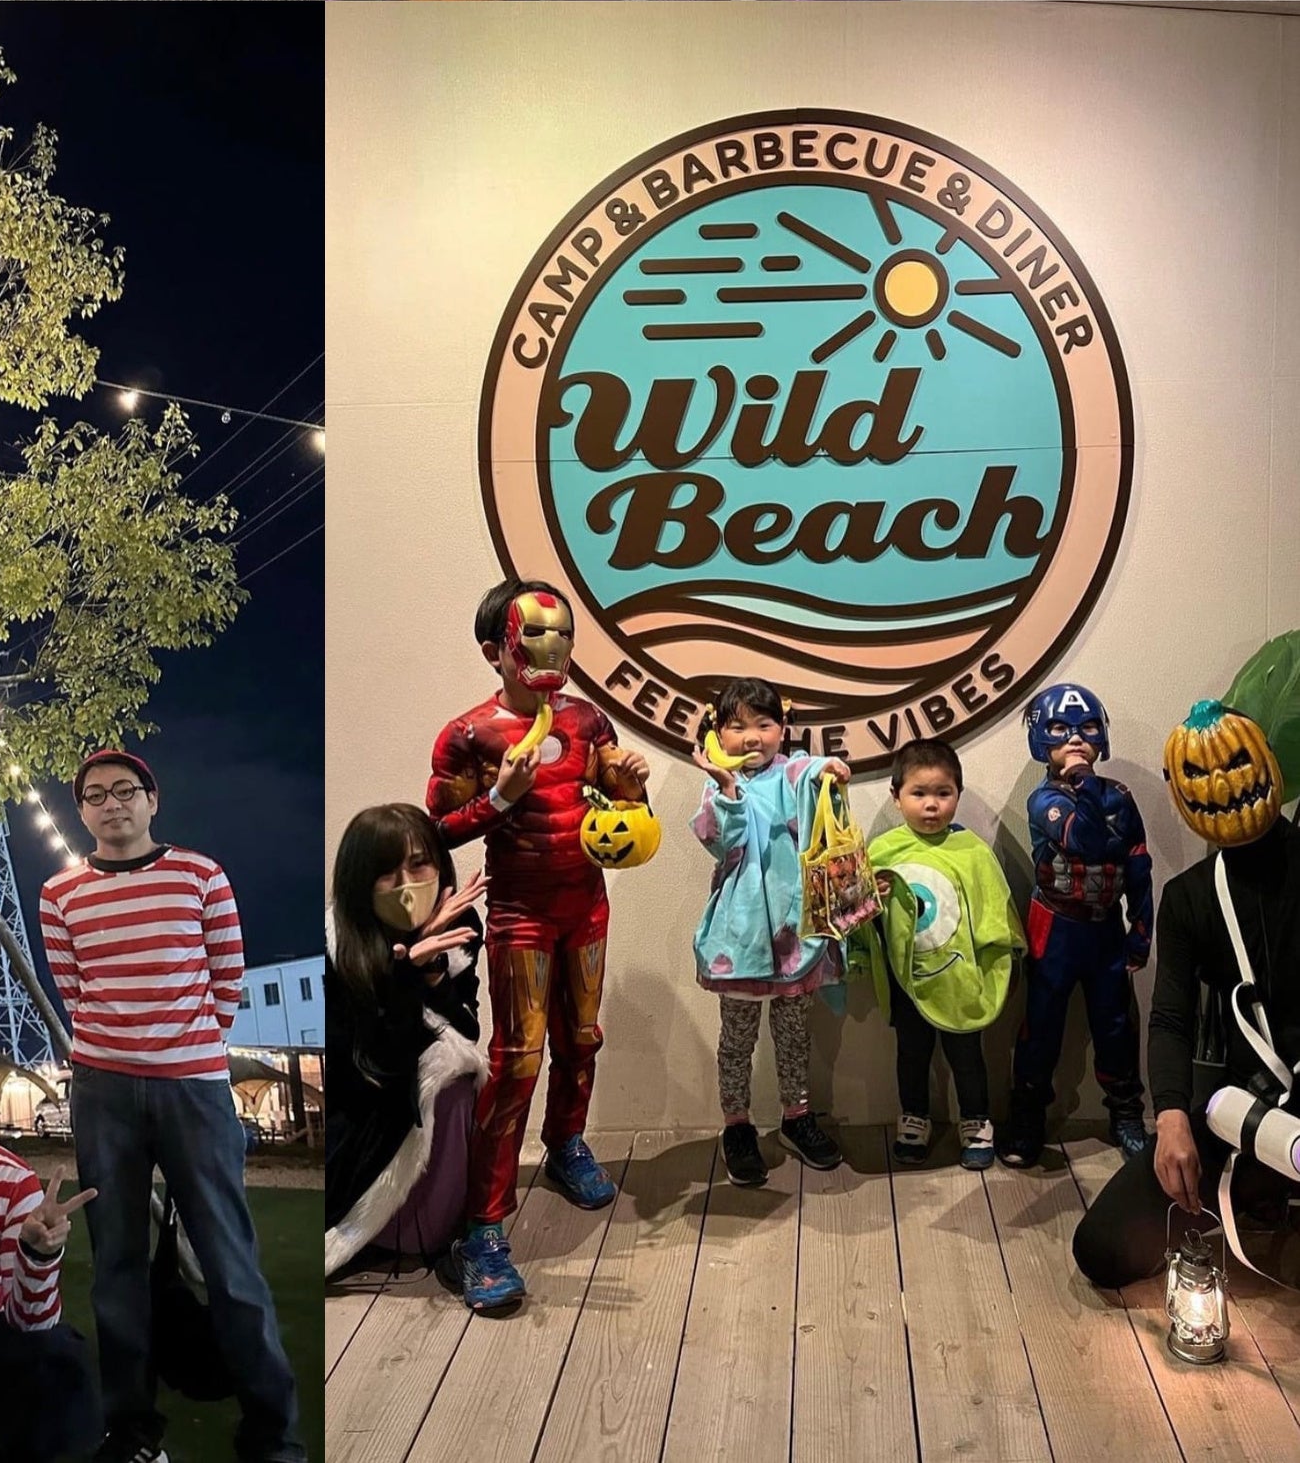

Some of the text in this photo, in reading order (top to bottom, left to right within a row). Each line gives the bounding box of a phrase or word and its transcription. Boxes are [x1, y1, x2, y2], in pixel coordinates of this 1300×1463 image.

[513, 130, 1094, 369] CAMP & BARBECUE & DINER
[549, 365, 925, 472] Wild
[586, 465, 1045, 571] Beach
[605, 653, 1015, 759] FEE HE VIBES
